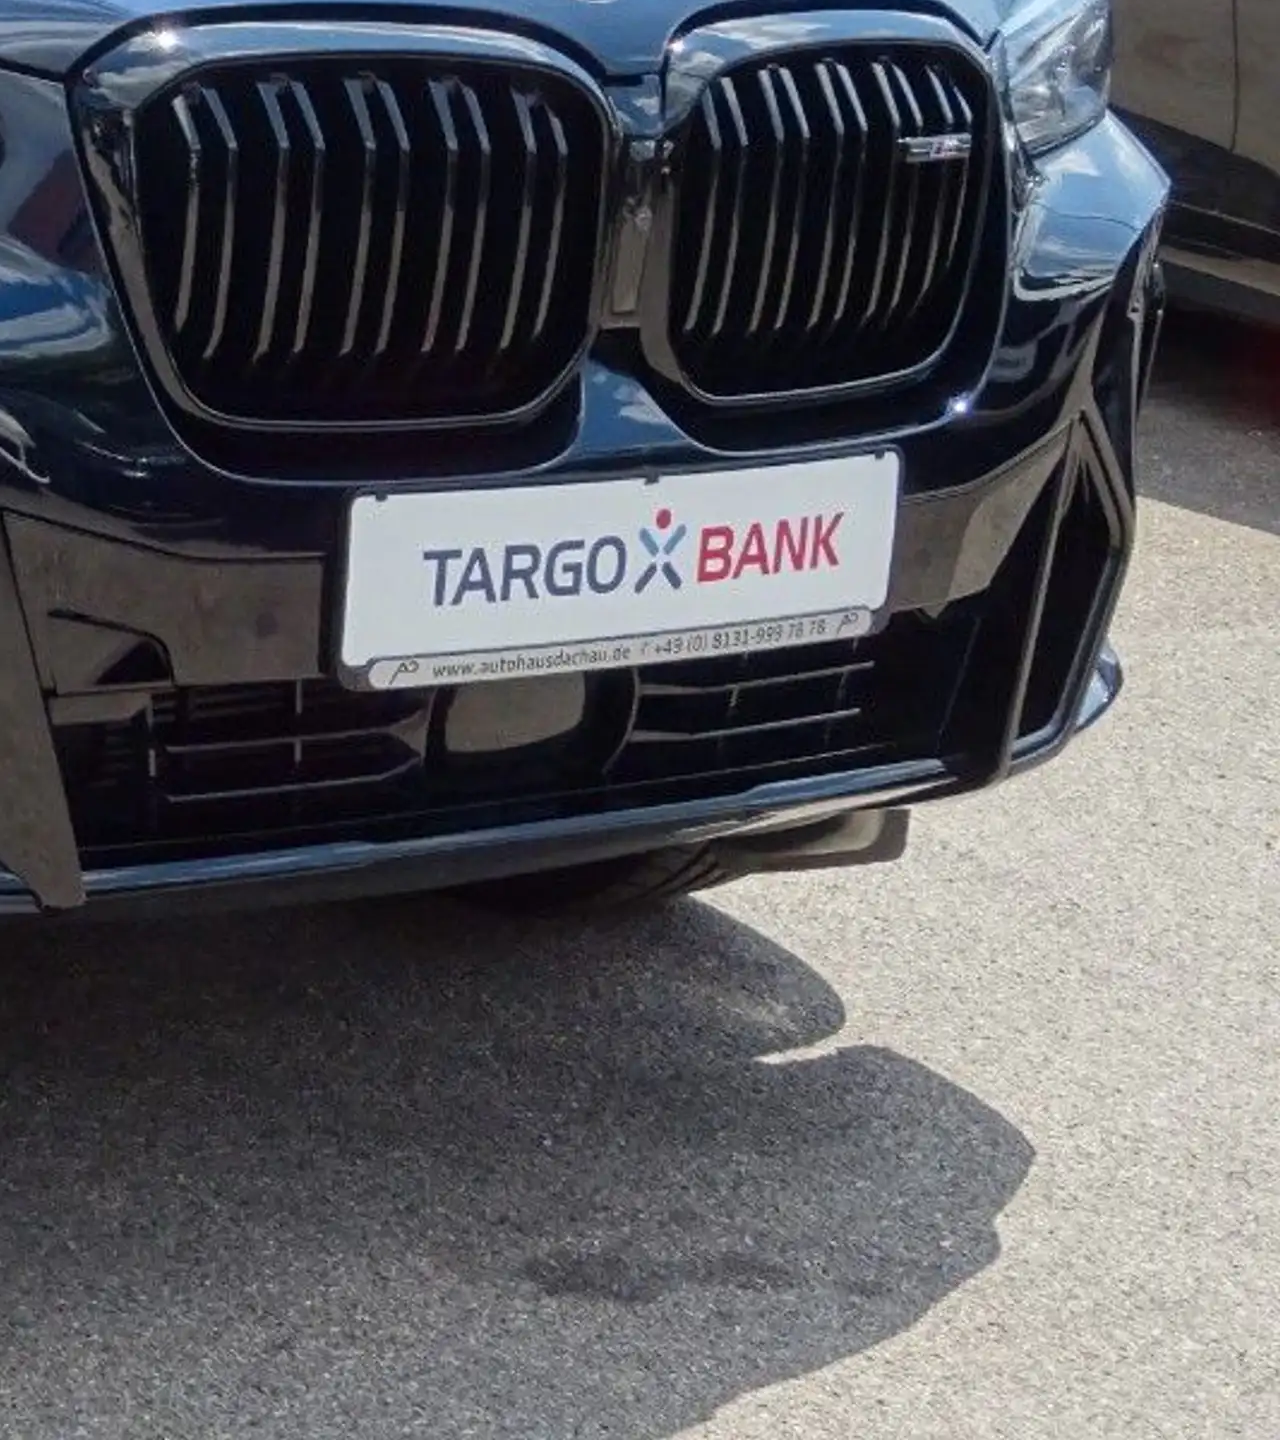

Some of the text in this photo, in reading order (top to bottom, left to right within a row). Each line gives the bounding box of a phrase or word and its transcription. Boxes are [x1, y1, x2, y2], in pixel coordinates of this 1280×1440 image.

[423, 512, 844, 606] TARGO BANK
[432, 644, 631, 677] www.autohausdachau.de
